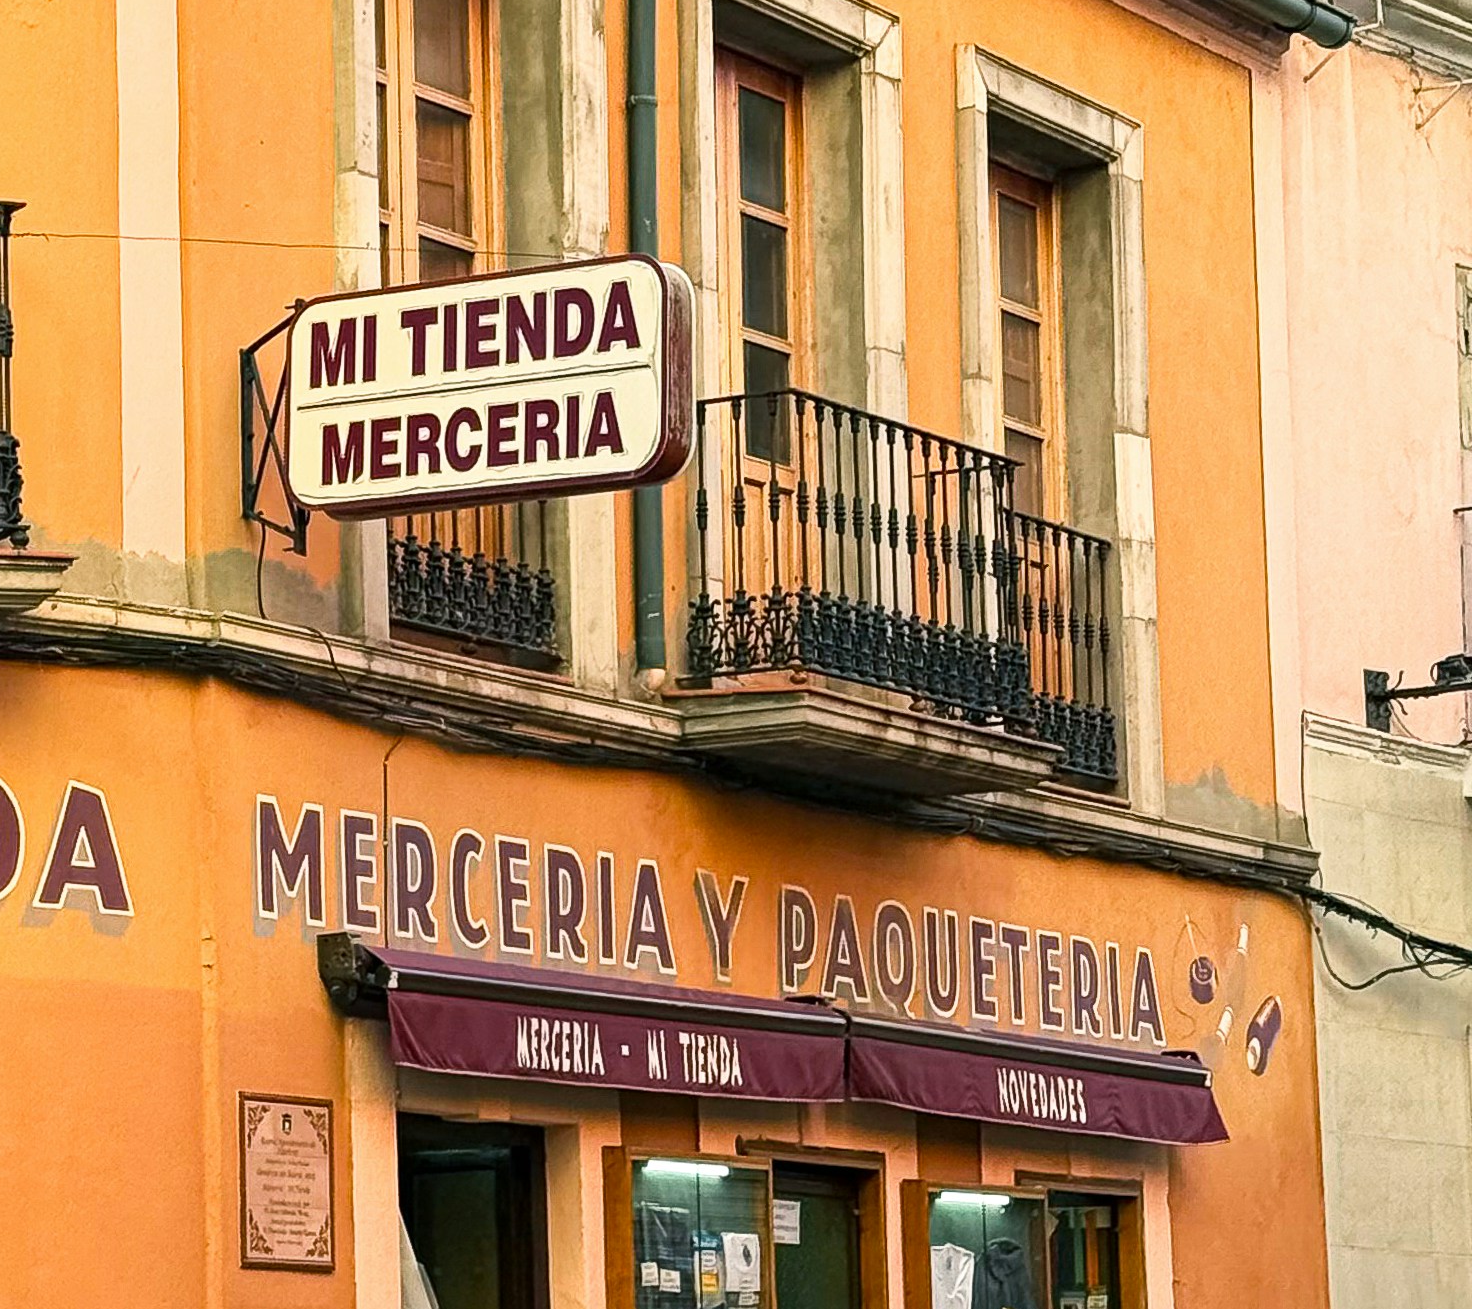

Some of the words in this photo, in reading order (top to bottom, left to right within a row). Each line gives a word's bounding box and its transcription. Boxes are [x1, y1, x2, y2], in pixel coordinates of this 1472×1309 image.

[309, 314, 377, 389] MI
[400, 280, 641, 376] TIENDA
[321, 391, 624, 487] MERCERIA
[255, 793, 677, 976] MERCERIA
[694, 867, 750, 983] Y
[780, 882, 1168, 1048] PAQUETERIA
[516, 1015, 605, 1077] MERCERIA
[646, 1028, 668, 1082] MI
[679, 1030, 743, 1087] TIENDA
[996, 1066, 1088, 1125] NOVEDADES
